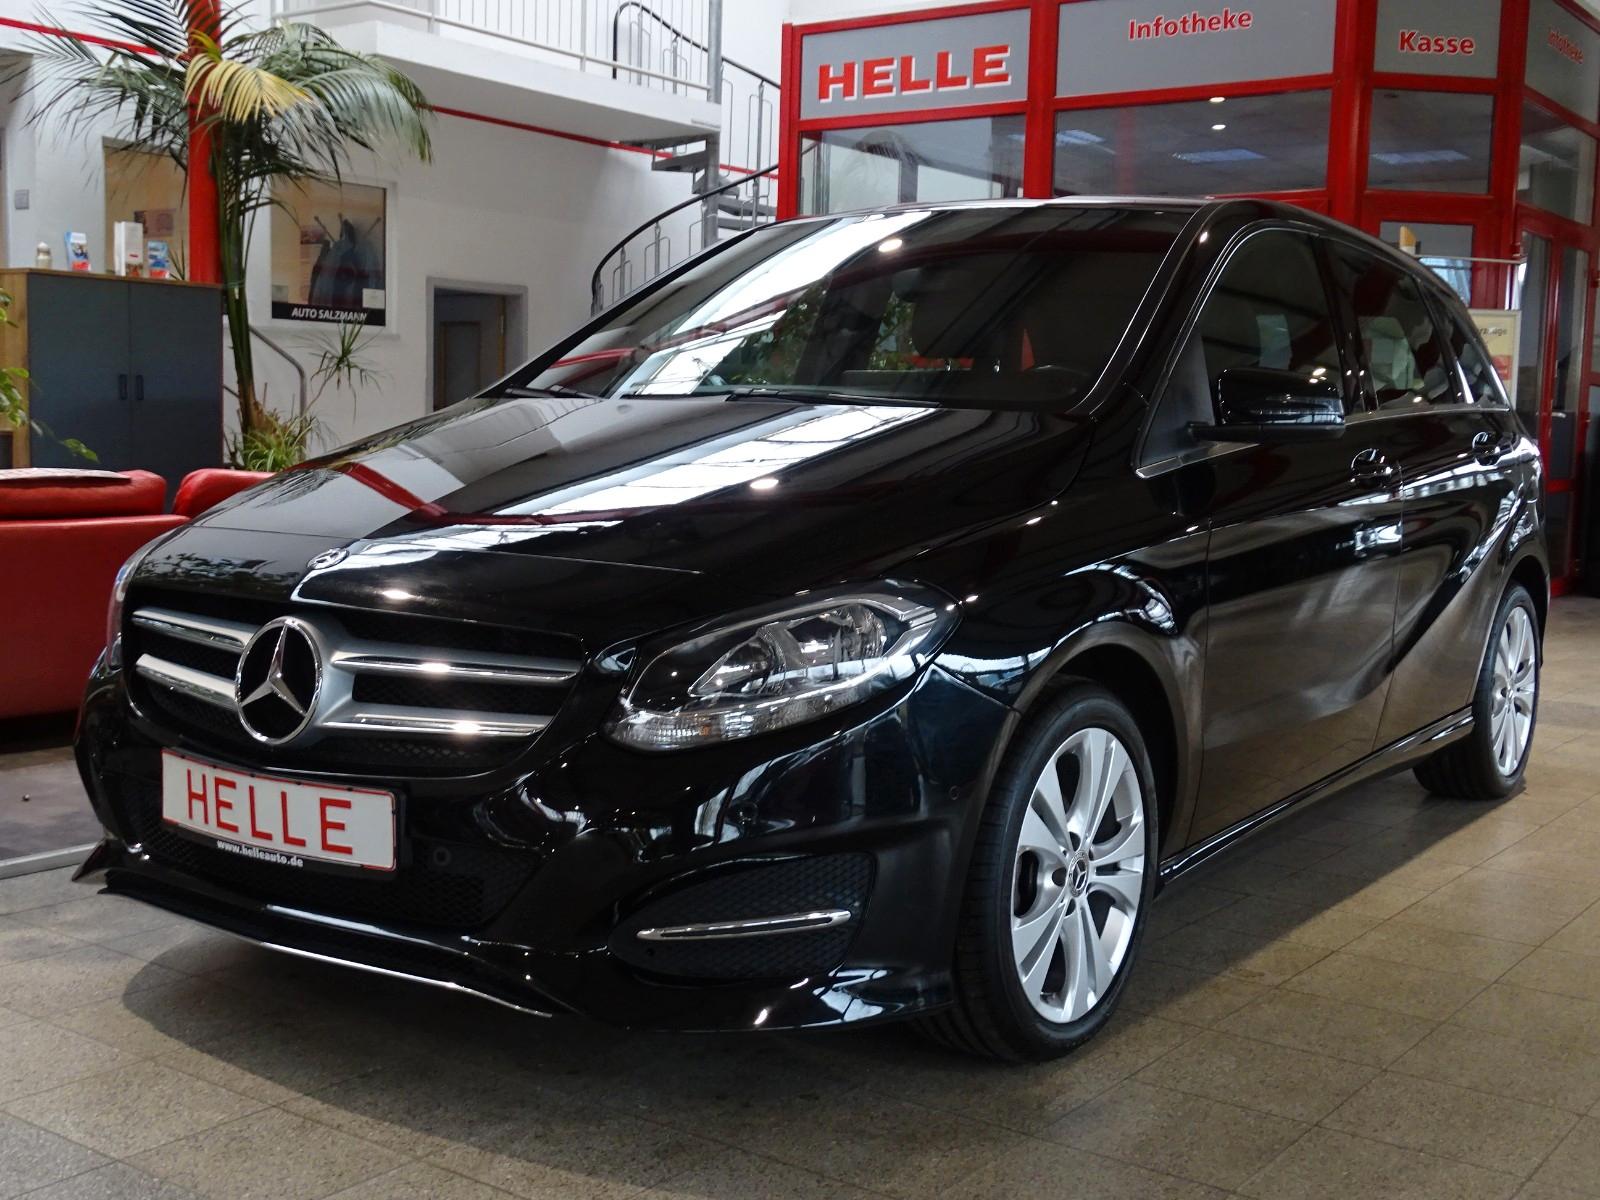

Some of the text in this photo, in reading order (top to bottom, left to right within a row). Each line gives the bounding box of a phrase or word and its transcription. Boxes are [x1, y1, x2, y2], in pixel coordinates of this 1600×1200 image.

[1128, 7, 1253, 40] Infotheke
[1399, 29, 1476, 55] Kasse
[818, 44, 1012, 103] HELLE
[291, 307, 367, 321] AUTO SALZMANN
[187, 768, 353, 855] HELLE
[216, 840, 304, 867] www.helleauto.de
